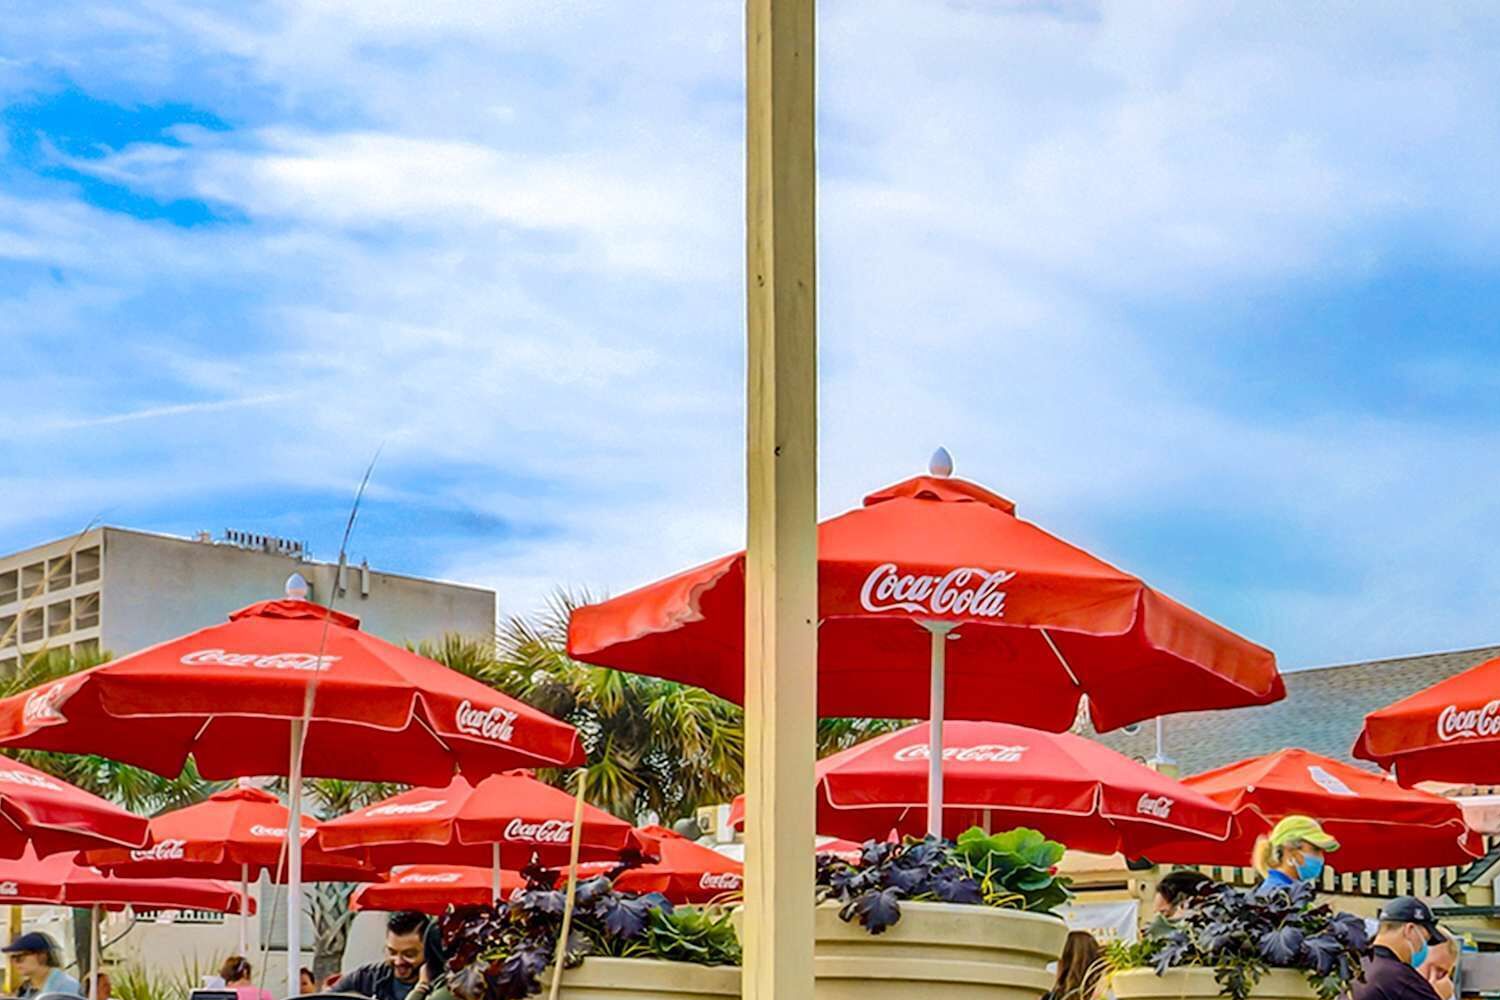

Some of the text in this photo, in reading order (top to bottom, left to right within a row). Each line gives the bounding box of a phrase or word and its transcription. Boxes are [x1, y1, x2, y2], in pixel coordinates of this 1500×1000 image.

[860, 563, 1017, 617] Coca-Cola
[455, 699, 518, 742] Coca-Cola
[893, 743, 1030, 762] Coa-Cola
[503, 817, 575, 843] Coca-Cola
